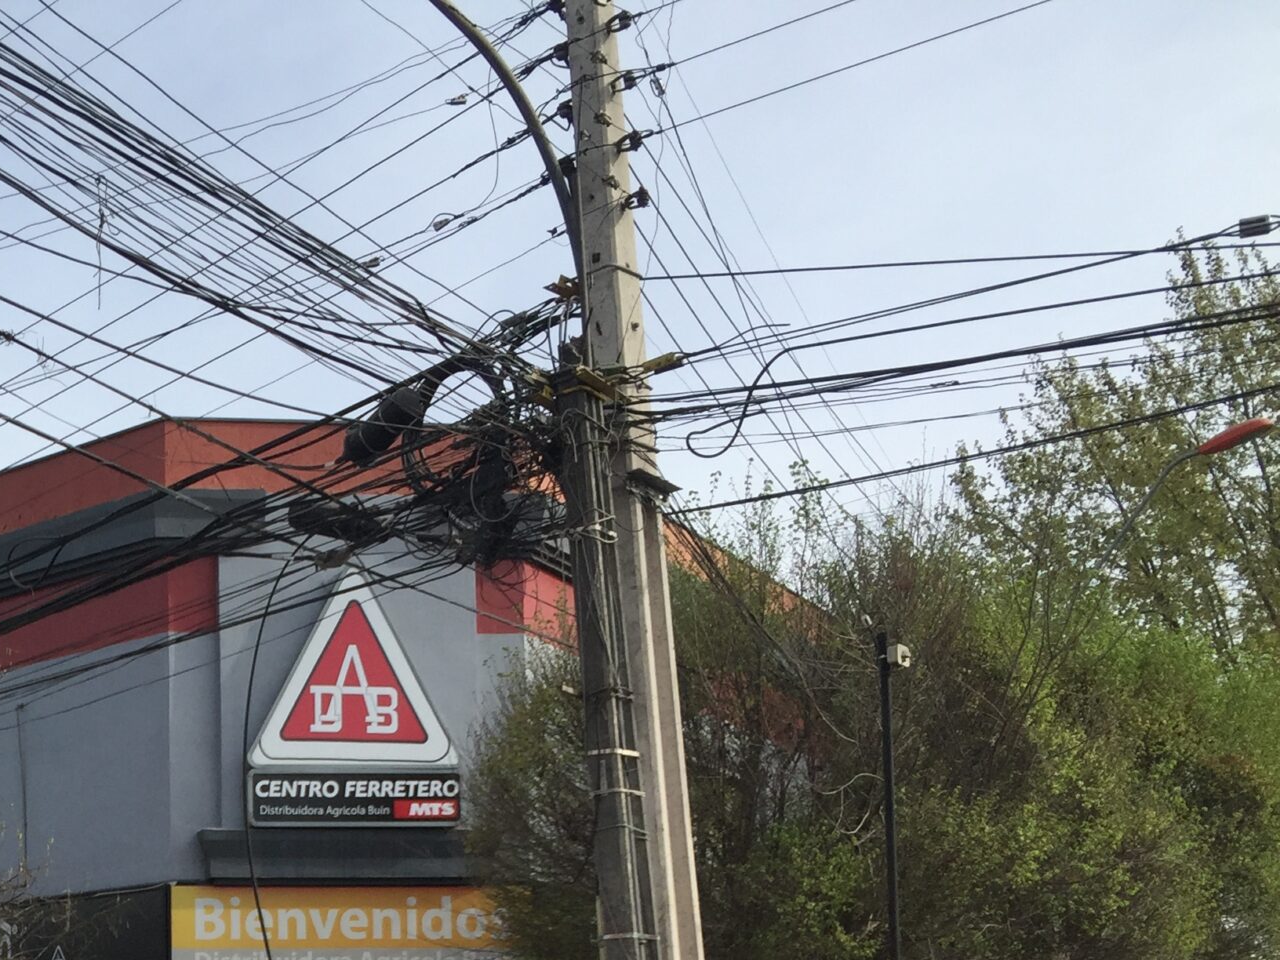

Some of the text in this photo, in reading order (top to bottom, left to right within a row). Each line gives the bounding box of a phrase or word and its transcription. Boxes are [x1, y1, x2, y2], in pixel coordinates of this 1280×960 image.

[255, 780, 459, 798] CENTRO FERRETERO
[259, 804, 324, 816] Distribuidora
[368, 805, 390, 816] Buin
[409, 803, 455, 816] MTS
